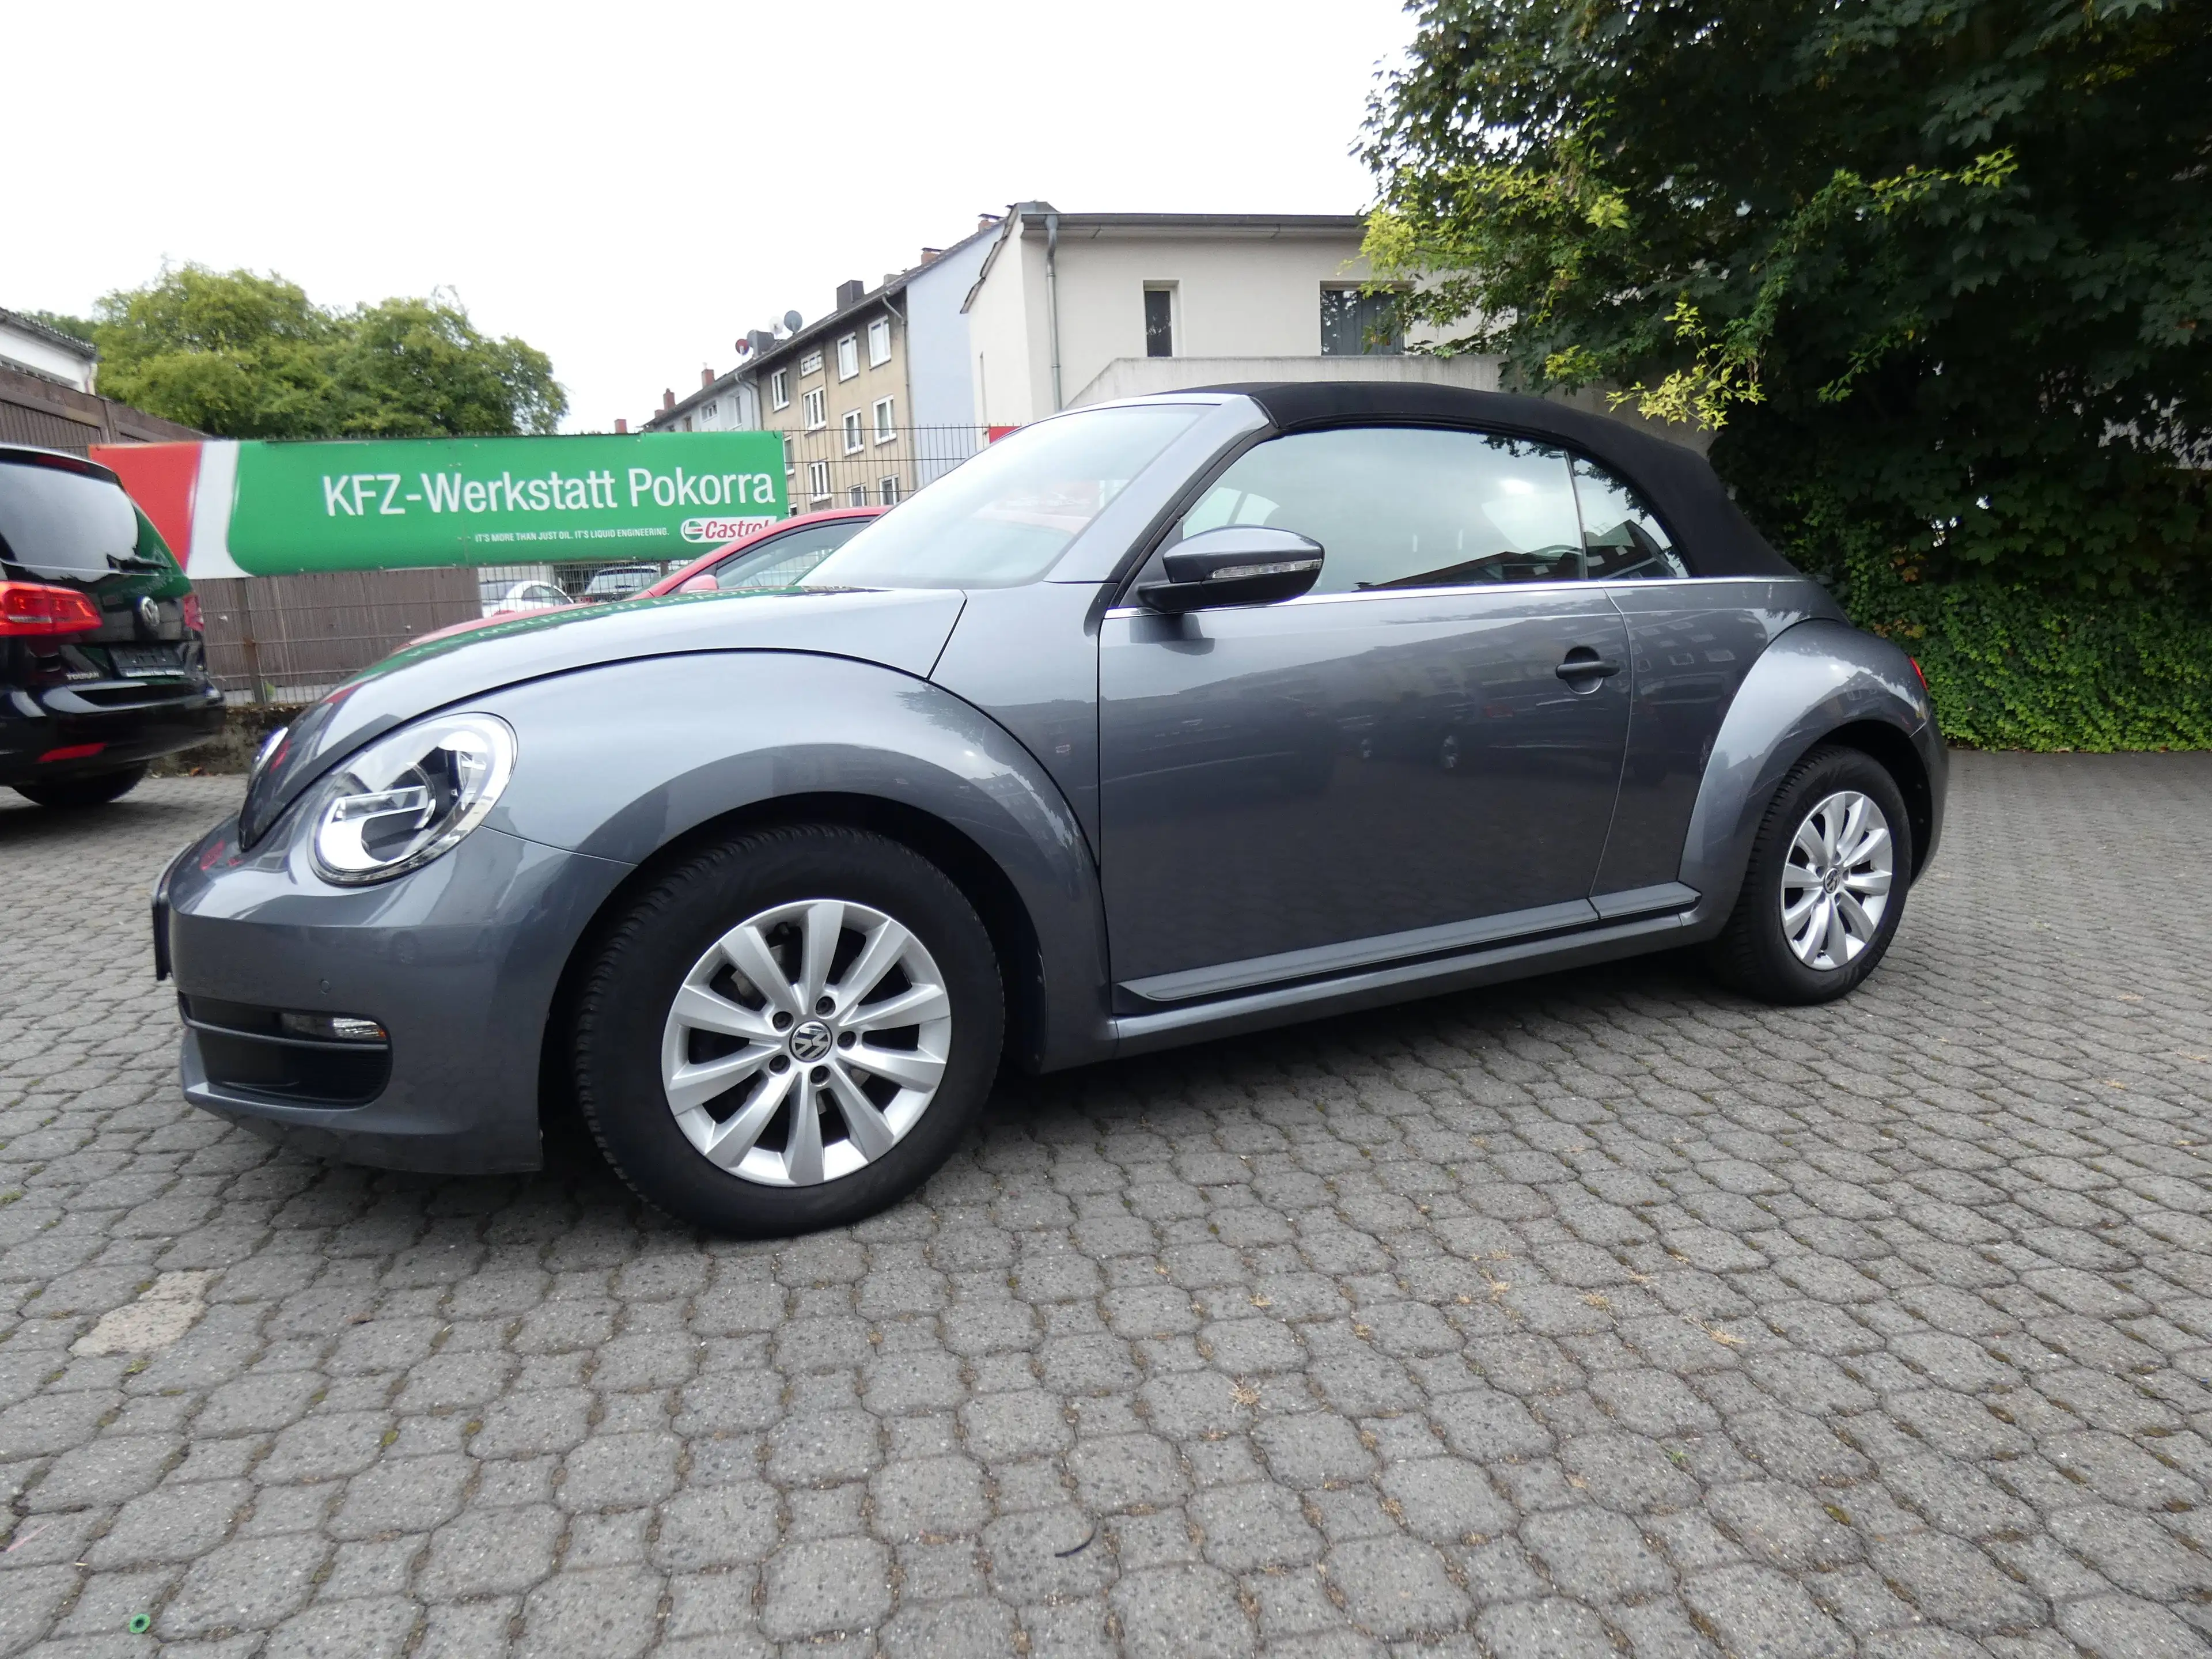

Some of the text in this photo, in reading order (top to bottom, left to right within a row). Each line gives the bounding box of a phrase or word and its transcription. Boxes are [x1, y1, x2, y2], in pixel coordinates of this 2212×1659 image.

[323, 467, 775, 516] KFZ-Werkstatt Pokorra
[475, 528, 670, 543] IT'S MORE THAN JUST OIL. IT'S LIQUID ENGINEERING.
